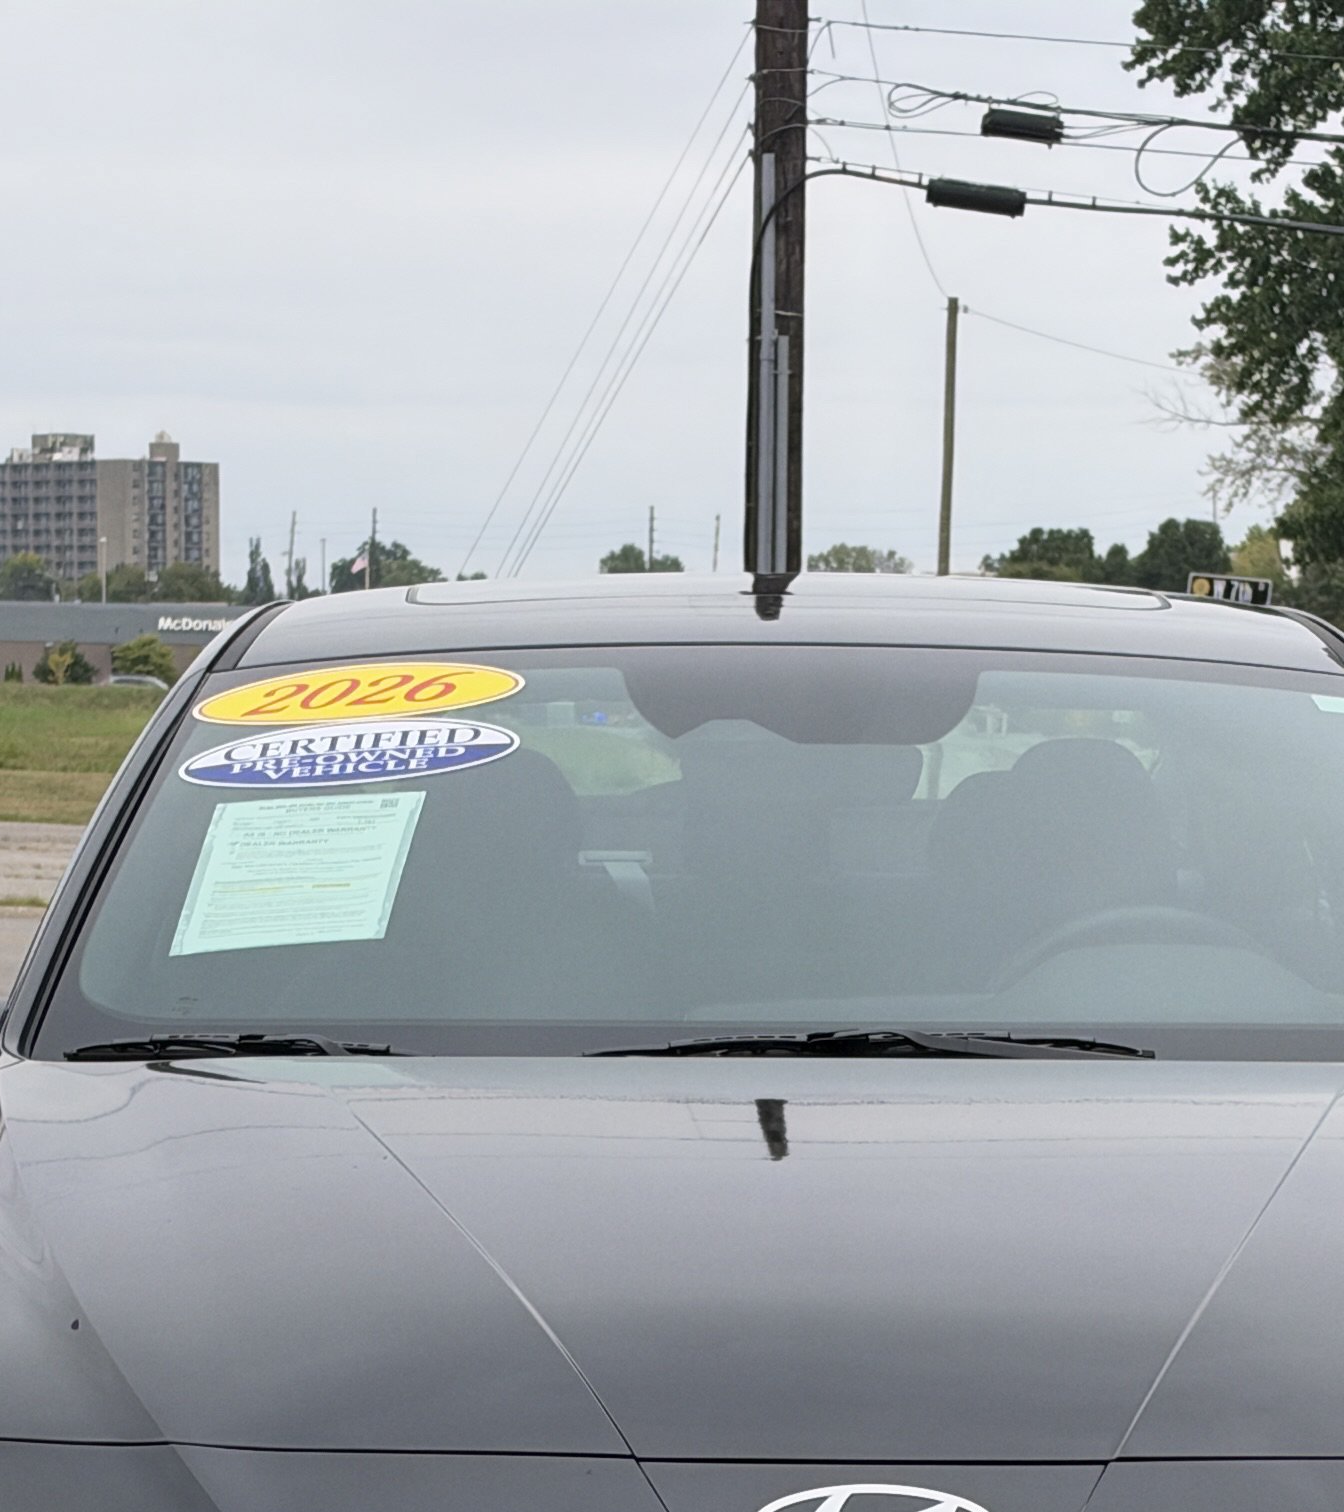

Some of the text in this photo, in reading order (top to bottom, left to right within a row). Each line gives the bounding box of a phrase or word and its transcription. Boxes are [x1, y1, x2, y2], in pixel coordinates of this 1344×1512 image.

[241, 671, 474, 717] 2026
[224, 727, 481, 762] CERTIFIED
[232, 746, 466, 774] PRE-OWNED
[264, 756, 428, 780] VEHICLE
